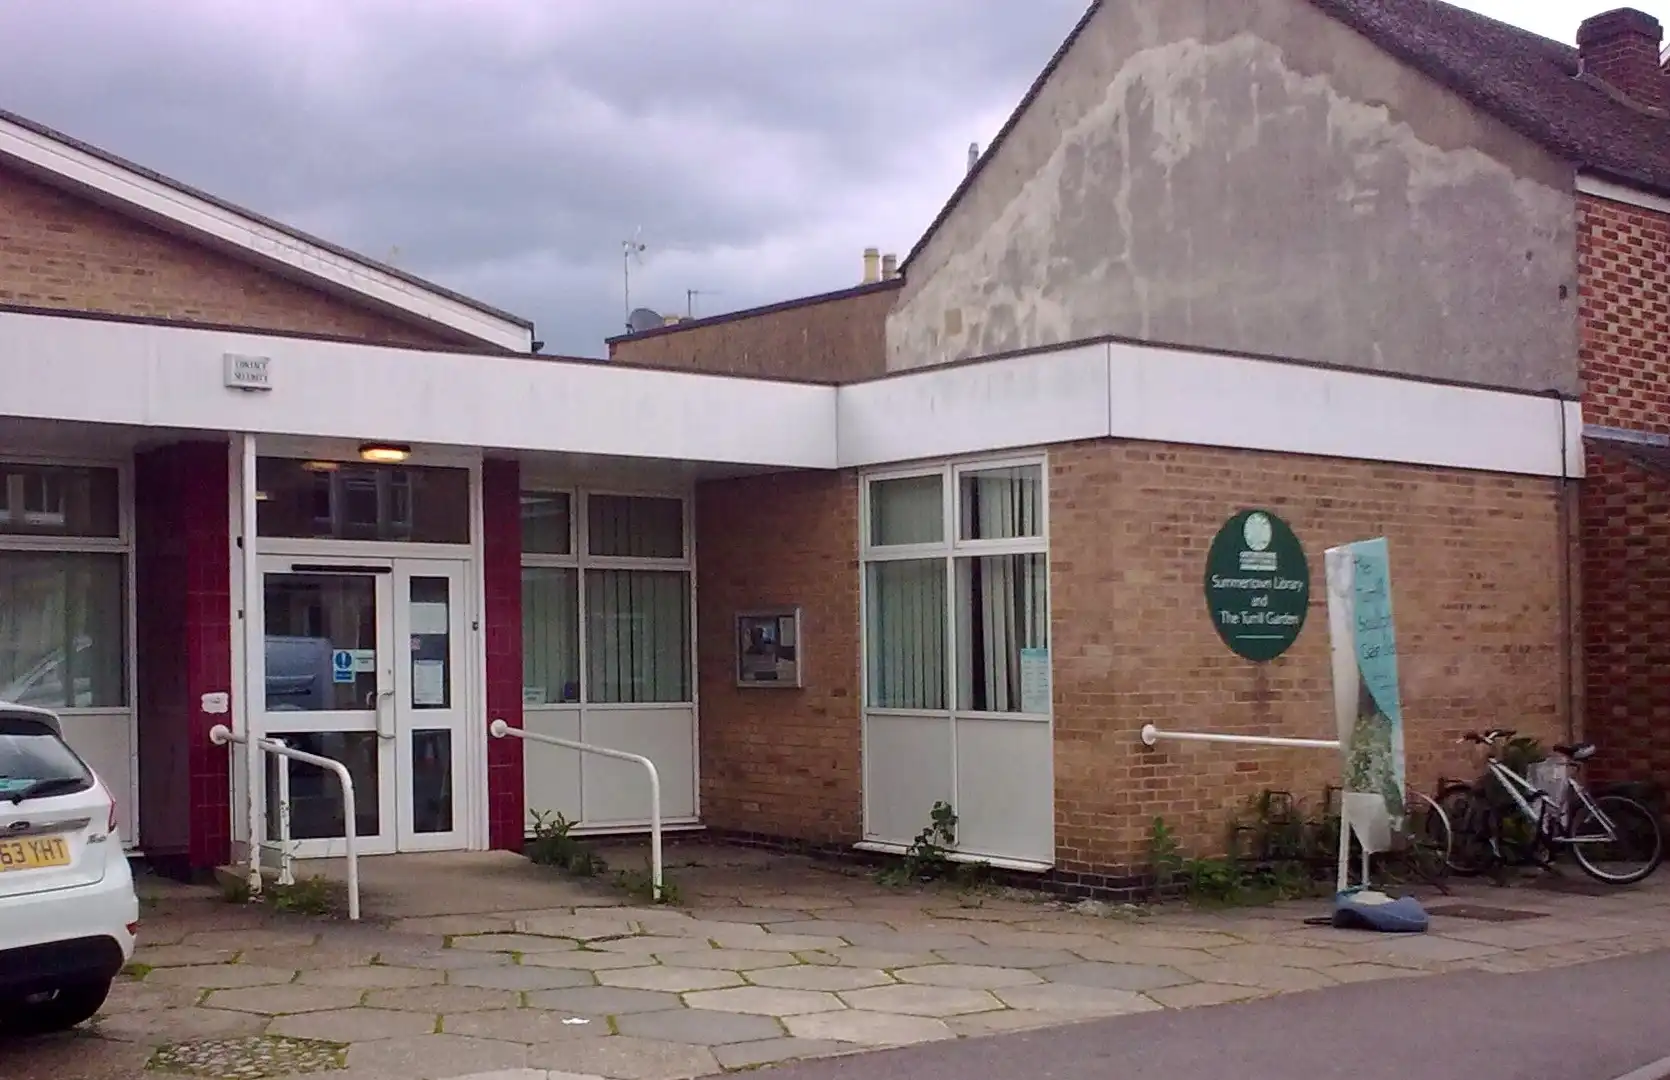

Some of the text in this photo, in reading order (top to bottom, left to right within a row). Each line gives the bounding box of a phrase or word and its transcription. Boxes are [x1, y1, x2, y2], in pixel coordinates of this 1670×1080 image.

[1211, 574, 1304, 592] Summertown Library
[1250, 594, 1269, 607] and
[1219, 610, 1240, 625] The
[1265, 611, 1299, 625] Garden
[28, 838, 63, 863] YHT
